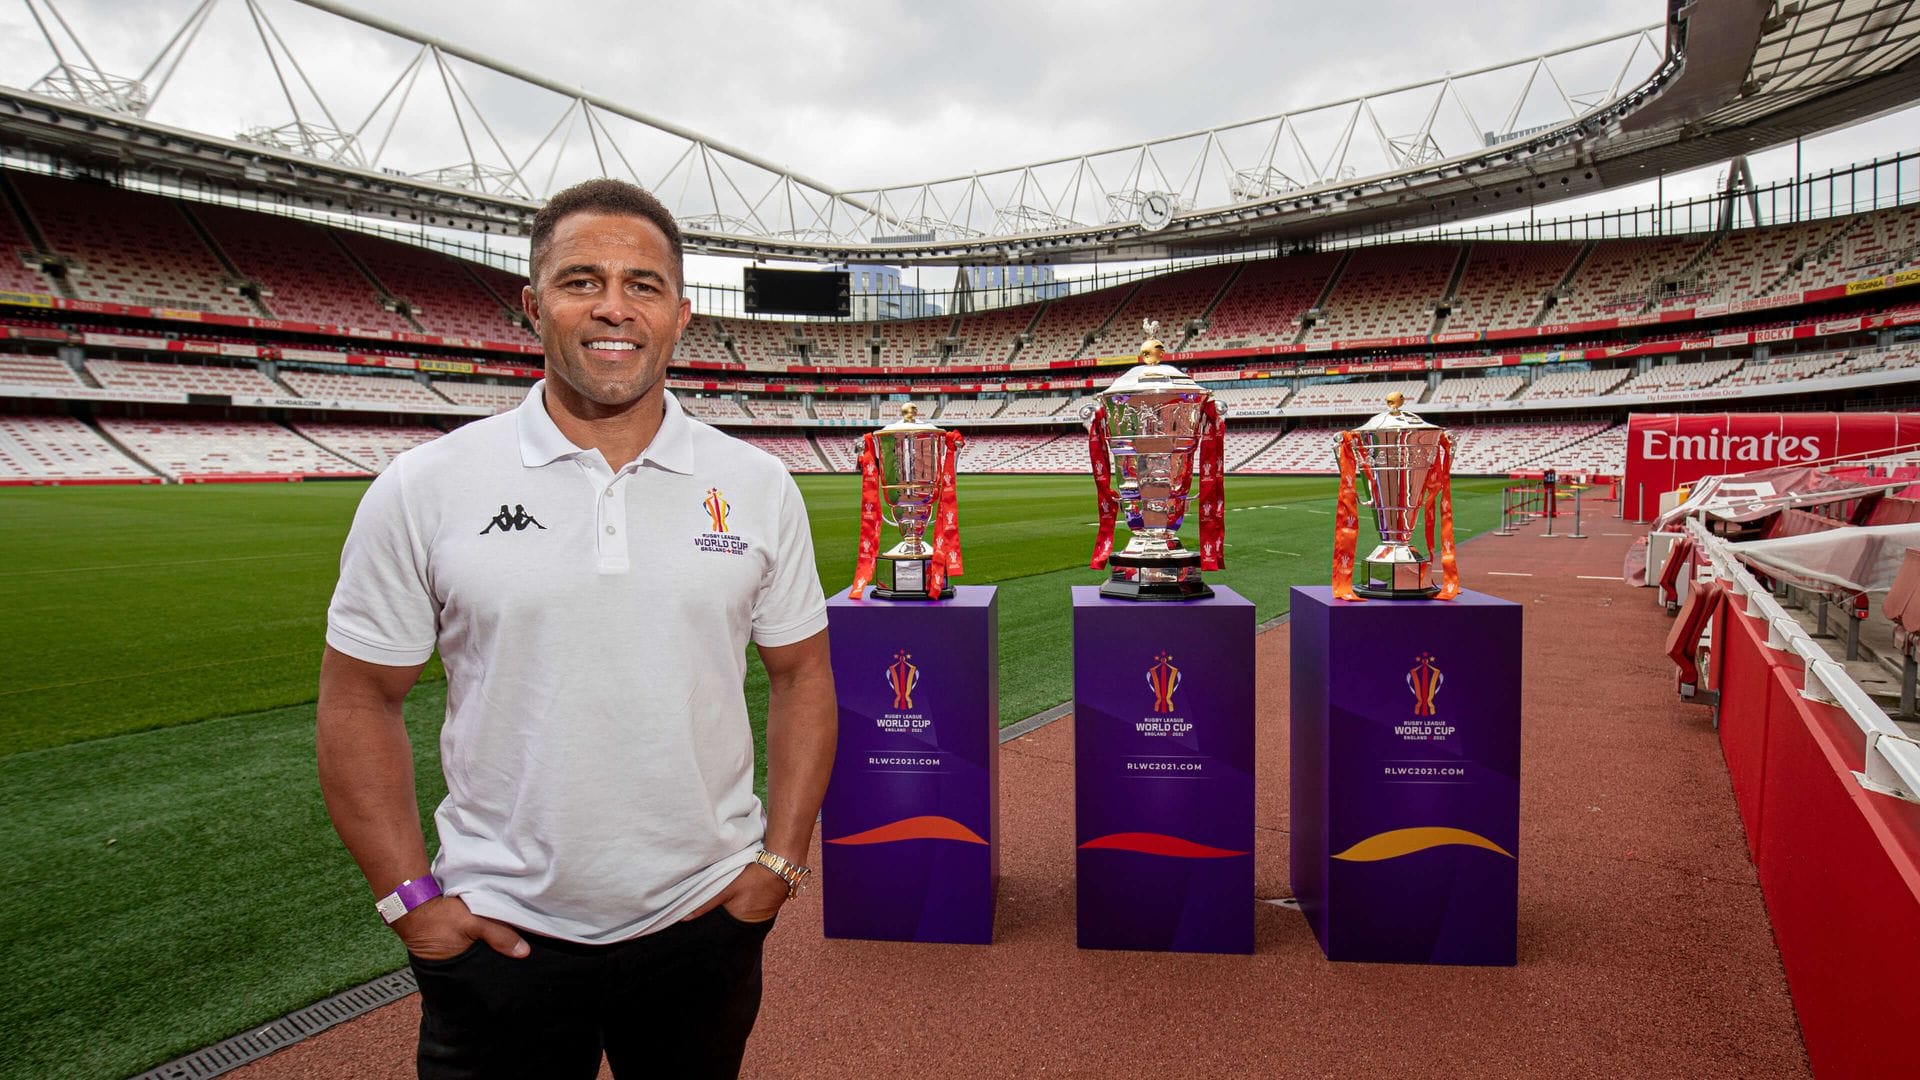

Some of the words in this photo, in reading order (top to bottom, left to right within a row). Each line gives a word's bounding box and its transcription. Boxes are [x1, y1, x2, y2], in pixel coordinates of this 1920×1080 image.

[1849, 280, 1884, 291] VIRGINIA
[1756, 328, 1792, 341] ROCKY
[1680, 339, 1713, 350] Arsenal
[1348, 365, 1390, 373] Arsenal.com
[1657, 392, 1681, 400] Emirates
[1723, 388, 1743, 396] Ocean
[1642, 428, 1820, 461] Emirates
[694, 538, 729, 547] WORLD
[731, 541, 748, 550] CUP
[877, 719, 910, 728] WORLD
[912, 720, 931, 728] CUP
[1135, 723, 1171, 731] WORLD
[1173, 723, 1193, 731] CUP
[1394, 726, 1432, 735] WORLD
[1434, 726, 1455, 735] CUP
[869, 757, 940, 766] RLWC2021.COM
[1384, 768, 1464, 776] RLWC2021.COM
